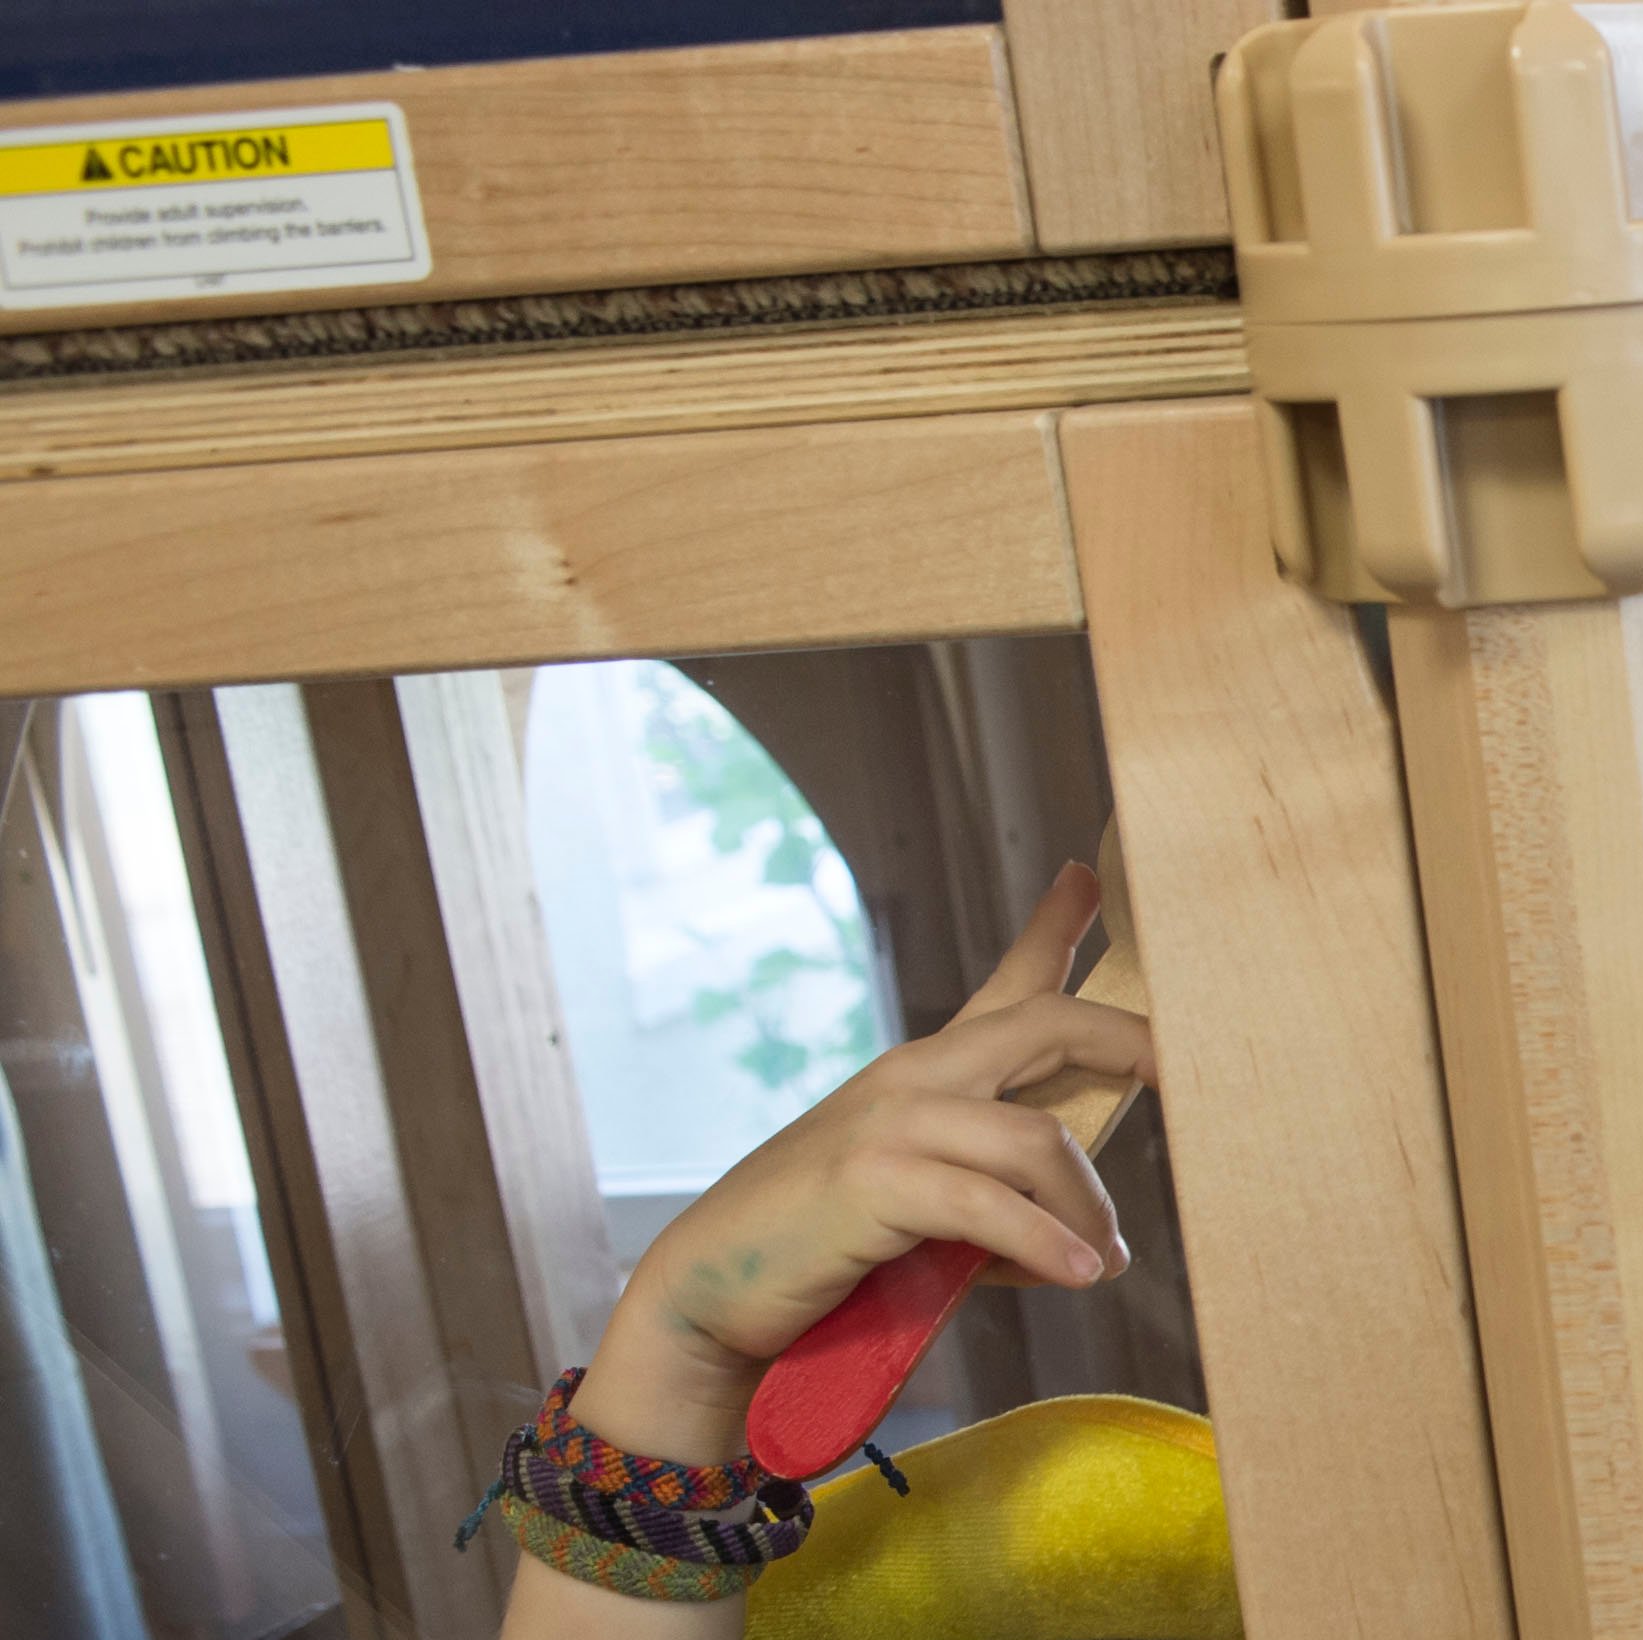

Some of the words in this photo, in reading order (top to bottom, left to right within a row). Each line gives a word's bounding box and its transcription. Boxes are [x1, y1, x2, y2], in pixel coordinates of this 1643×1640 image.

[118, 134, 290, 178] CAUTION
[84, 206, 150, 224] Provide
[157, 202, 198, 221] adult
[17, 236, 82, 255] Prohibit
[90, 233, 155, 252] children
[161, 230, 200, 247] from
[207, 226, 281, 246] climbing
[284, 222, 311, 238] the
